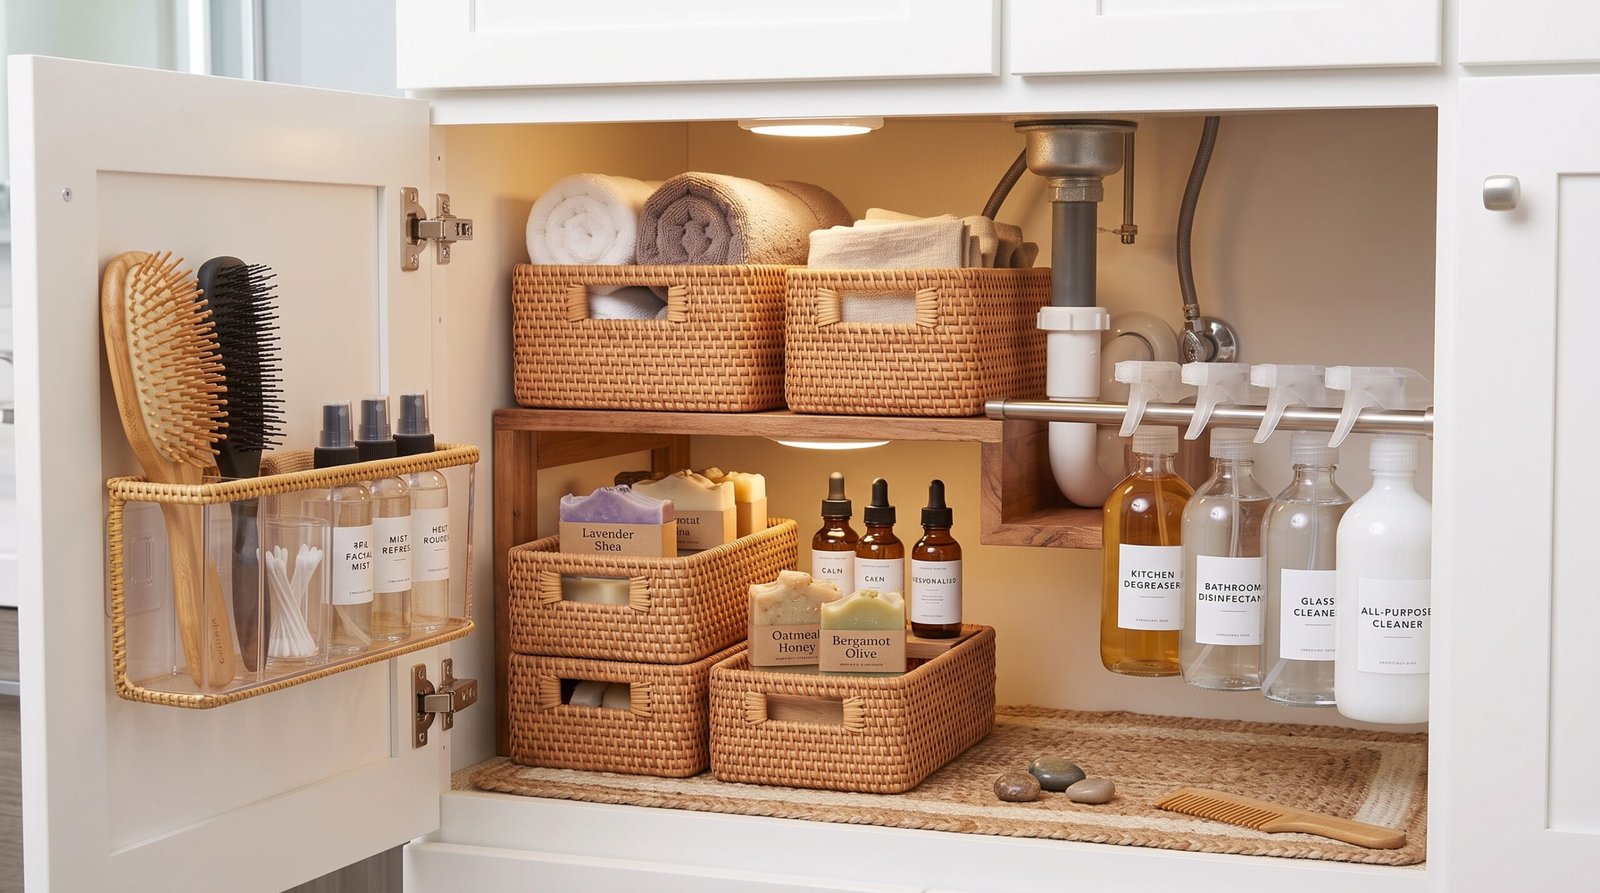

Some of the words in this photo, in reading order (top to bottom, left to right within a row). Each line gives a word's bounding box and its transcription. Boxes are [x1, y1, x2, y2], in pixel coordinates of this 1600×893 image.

[389, 534, 408, 543] MIST
[582, 528, 634, 539] Lavender
[382, 544, 411, 554] REFRES
[594, 540, 622, 551] Shea
[351, 561, 371, 571] MIST
[864, 575, 885, 583] CAEN
[1131, 570, 1175, 579] KITCHEN
[1124, 581, 1181, 590] DEGREASER
[1205, 582, 1262, 592] BATHROOM
[1198, 593, 1262, 603] DISINFECTAN
[1301, 597, 1335, 606] GLASS
[1293, 608, 1335, 617] CLEANE
[1361, 607, 1432, 617] ALL-PURPOSE
[1372, 619, 1423, 629] CLEANER
[772, 629, 820, 641] Oatmeal
[832, 635, 891, 648] Bergamot
[778, 643, 816, 654] Honey
[845, 648, 877, 659] Olive
